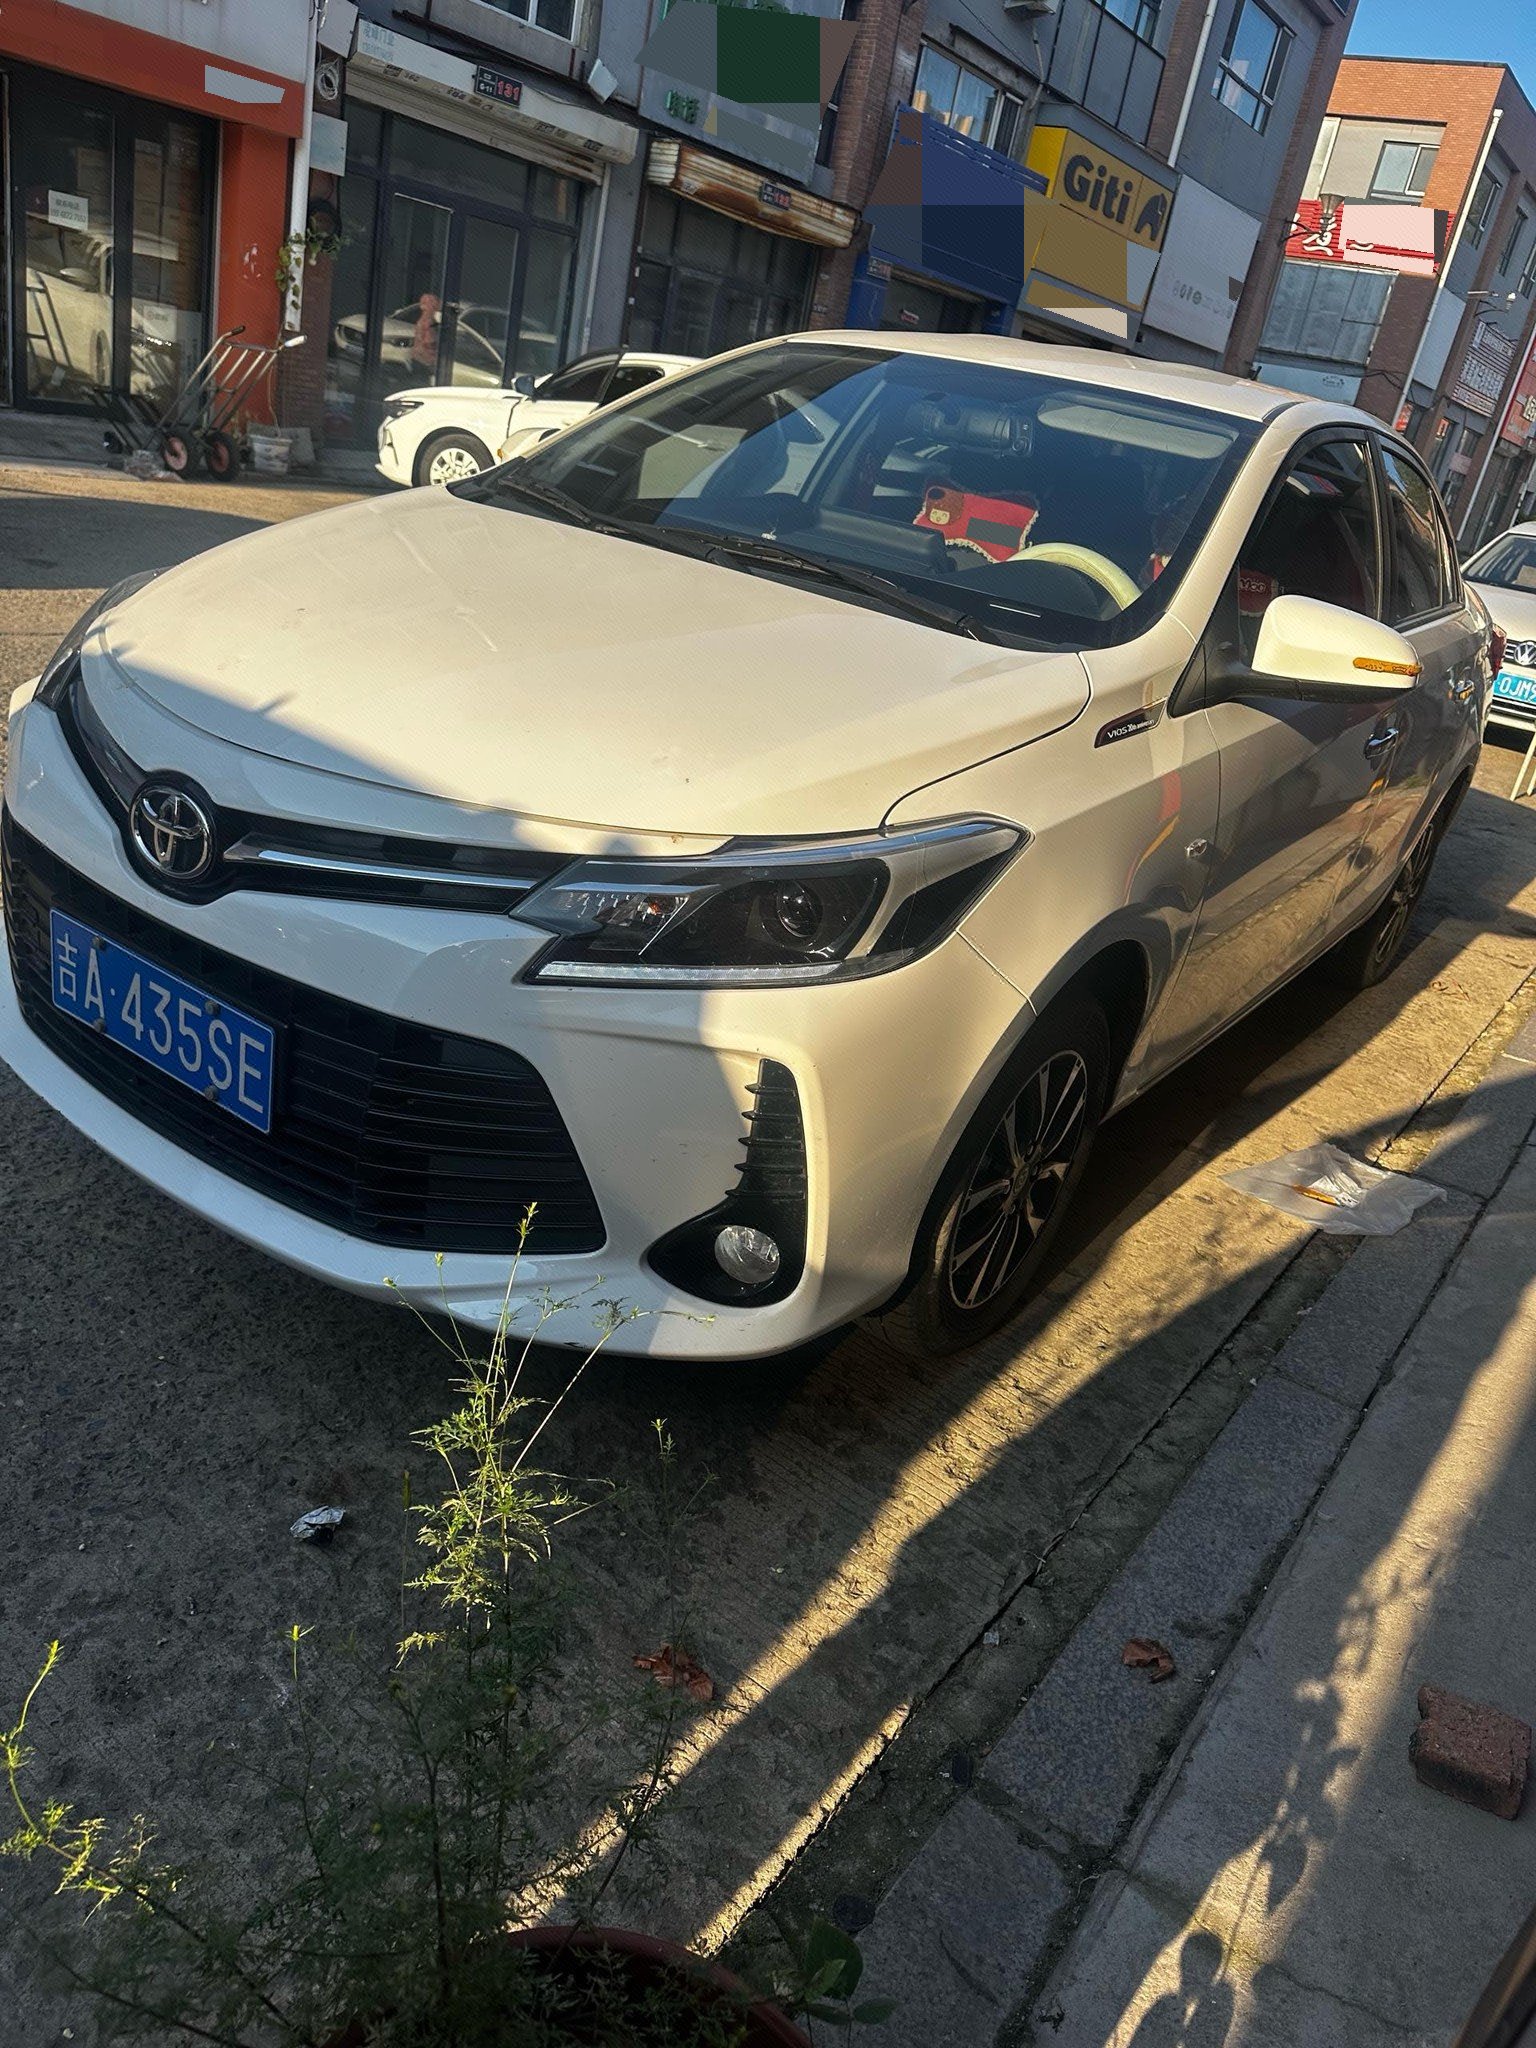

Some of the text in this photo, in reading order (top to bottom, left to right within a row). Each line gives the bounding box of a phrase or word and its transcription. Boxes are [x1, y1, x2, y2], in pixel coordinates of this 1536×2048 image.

[497, 80, 520, 101] 131
[1064, 154, 1134, 224] Giti
[1107, 726, 1128, 738] VIOS
